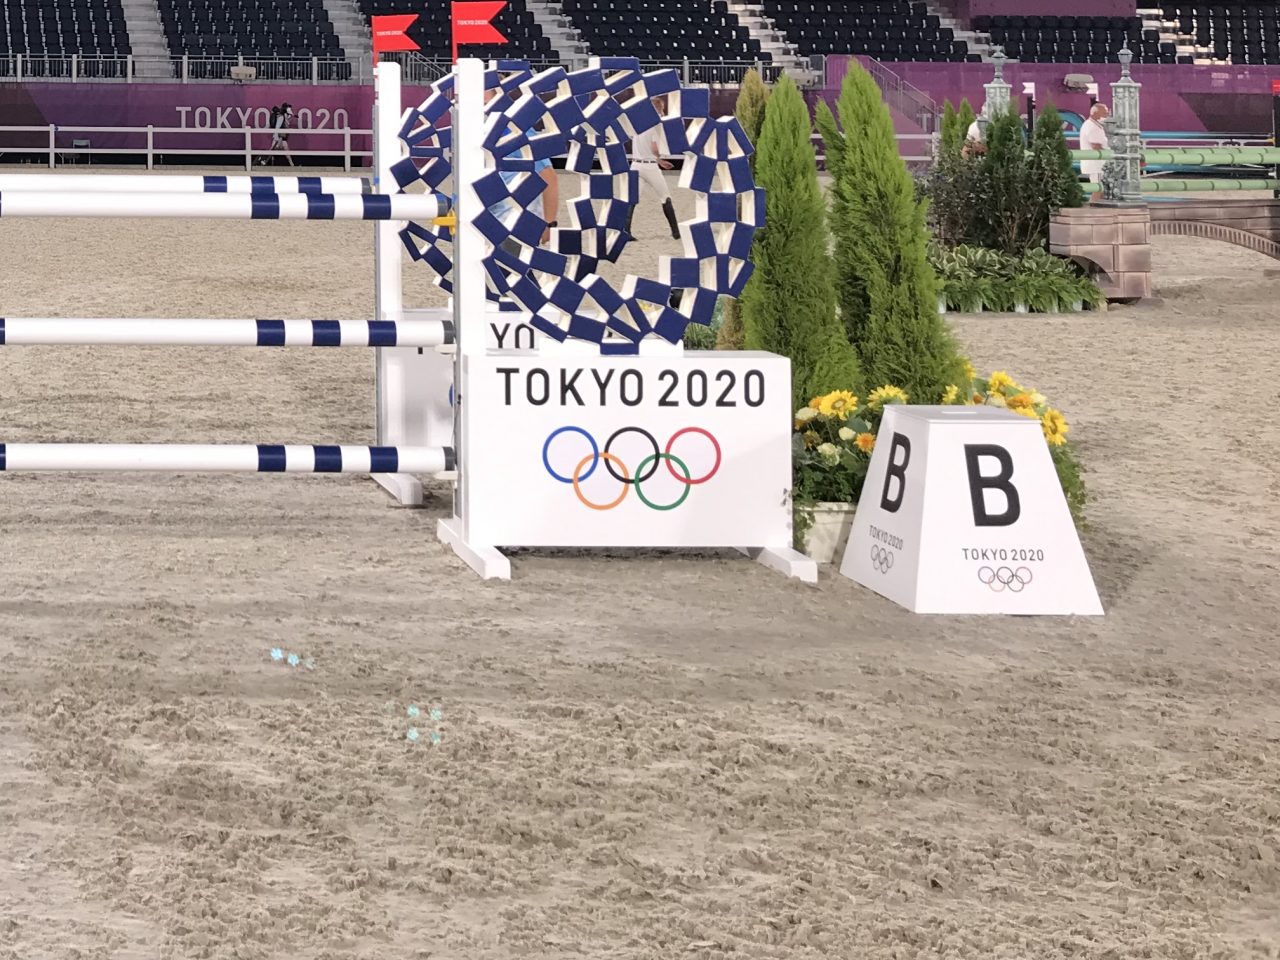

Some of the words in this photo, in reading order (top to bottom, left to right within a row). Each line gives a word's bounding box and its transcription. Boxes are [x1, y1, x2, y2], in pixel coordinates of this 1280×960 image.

[176, 106, 271, 130] TOKYO
[284, 108, 349, 130] 020
[496, 367, 644, 406] TOKYO
[657, 368, 766, 407] 2020
[880, 431, 911, 513] B
[964, 443, 1021, 527] B
[869, 524, 888, 545] TOKYO
[887, 533, 904, 551] 2020
[962, 548, 1008, 562] TOKYO
[1010, 548, 1045, 562] 2020
